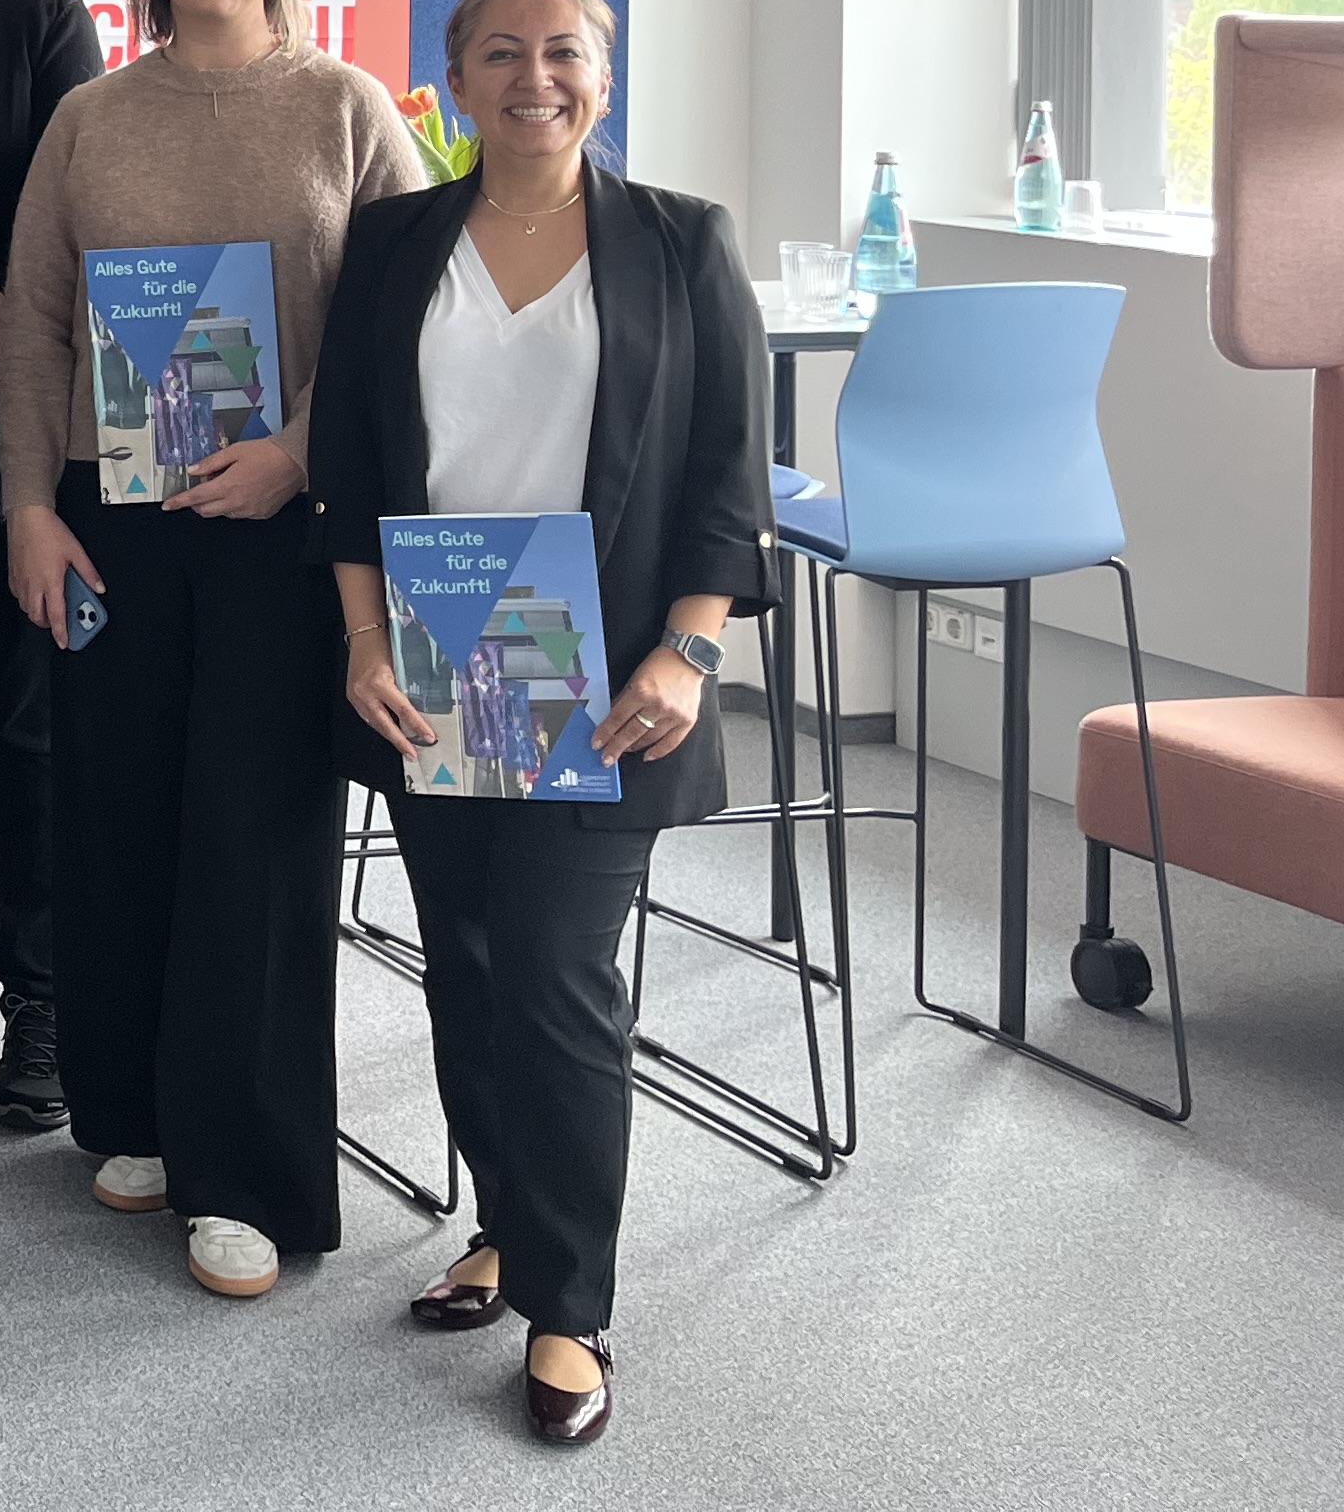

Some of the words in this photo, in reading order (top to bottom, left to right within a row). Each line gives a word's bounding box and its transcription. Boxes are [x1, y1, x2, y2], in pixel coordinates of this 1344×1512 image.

[95, 261, 133, 276] Alles
[136, 259, 177, 274] Gute
[142, 281, 167, 296] für
[172, 279, 197, 295] die
[110, 302, 182, 319] Zukunft!
[392, 531, 435, 547] Alles
[439, 530, 485, 546] Gute
[446, 554, 474, 570] für
[478, 554, 508, 570] die
[410, 578, 491, 594] Zukunft!
